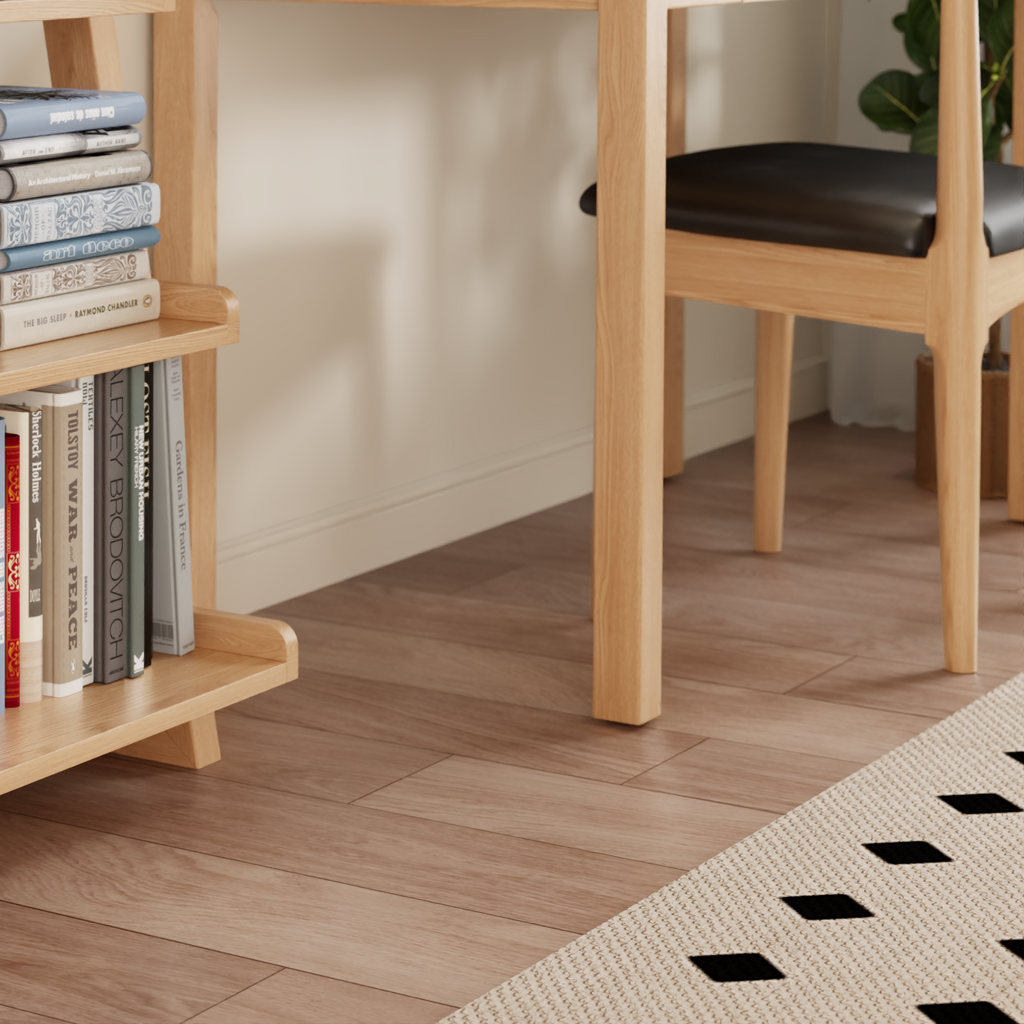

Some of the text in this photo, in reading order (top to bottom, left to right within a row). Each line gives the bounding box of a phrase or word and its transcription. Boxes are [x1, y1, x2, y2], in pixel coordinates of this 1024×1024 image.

[42, 237, 134, 262] art deco
[23, 299, 138, 328] THE BIG SLEEP RAYMOND CHANDLER
[32, 410, 42, 503] Sherlock Holmes
[68, 410, 78, 469] TOLSTOY
[68, 478, 78, 543] WAR
[175, 440, 187, 570] Gardens in France
[29, 588, 41, 603] DOYLE
[110, 477, 123, 660] BRODOVITCH
[68, 565, 78, 651] PEACE
